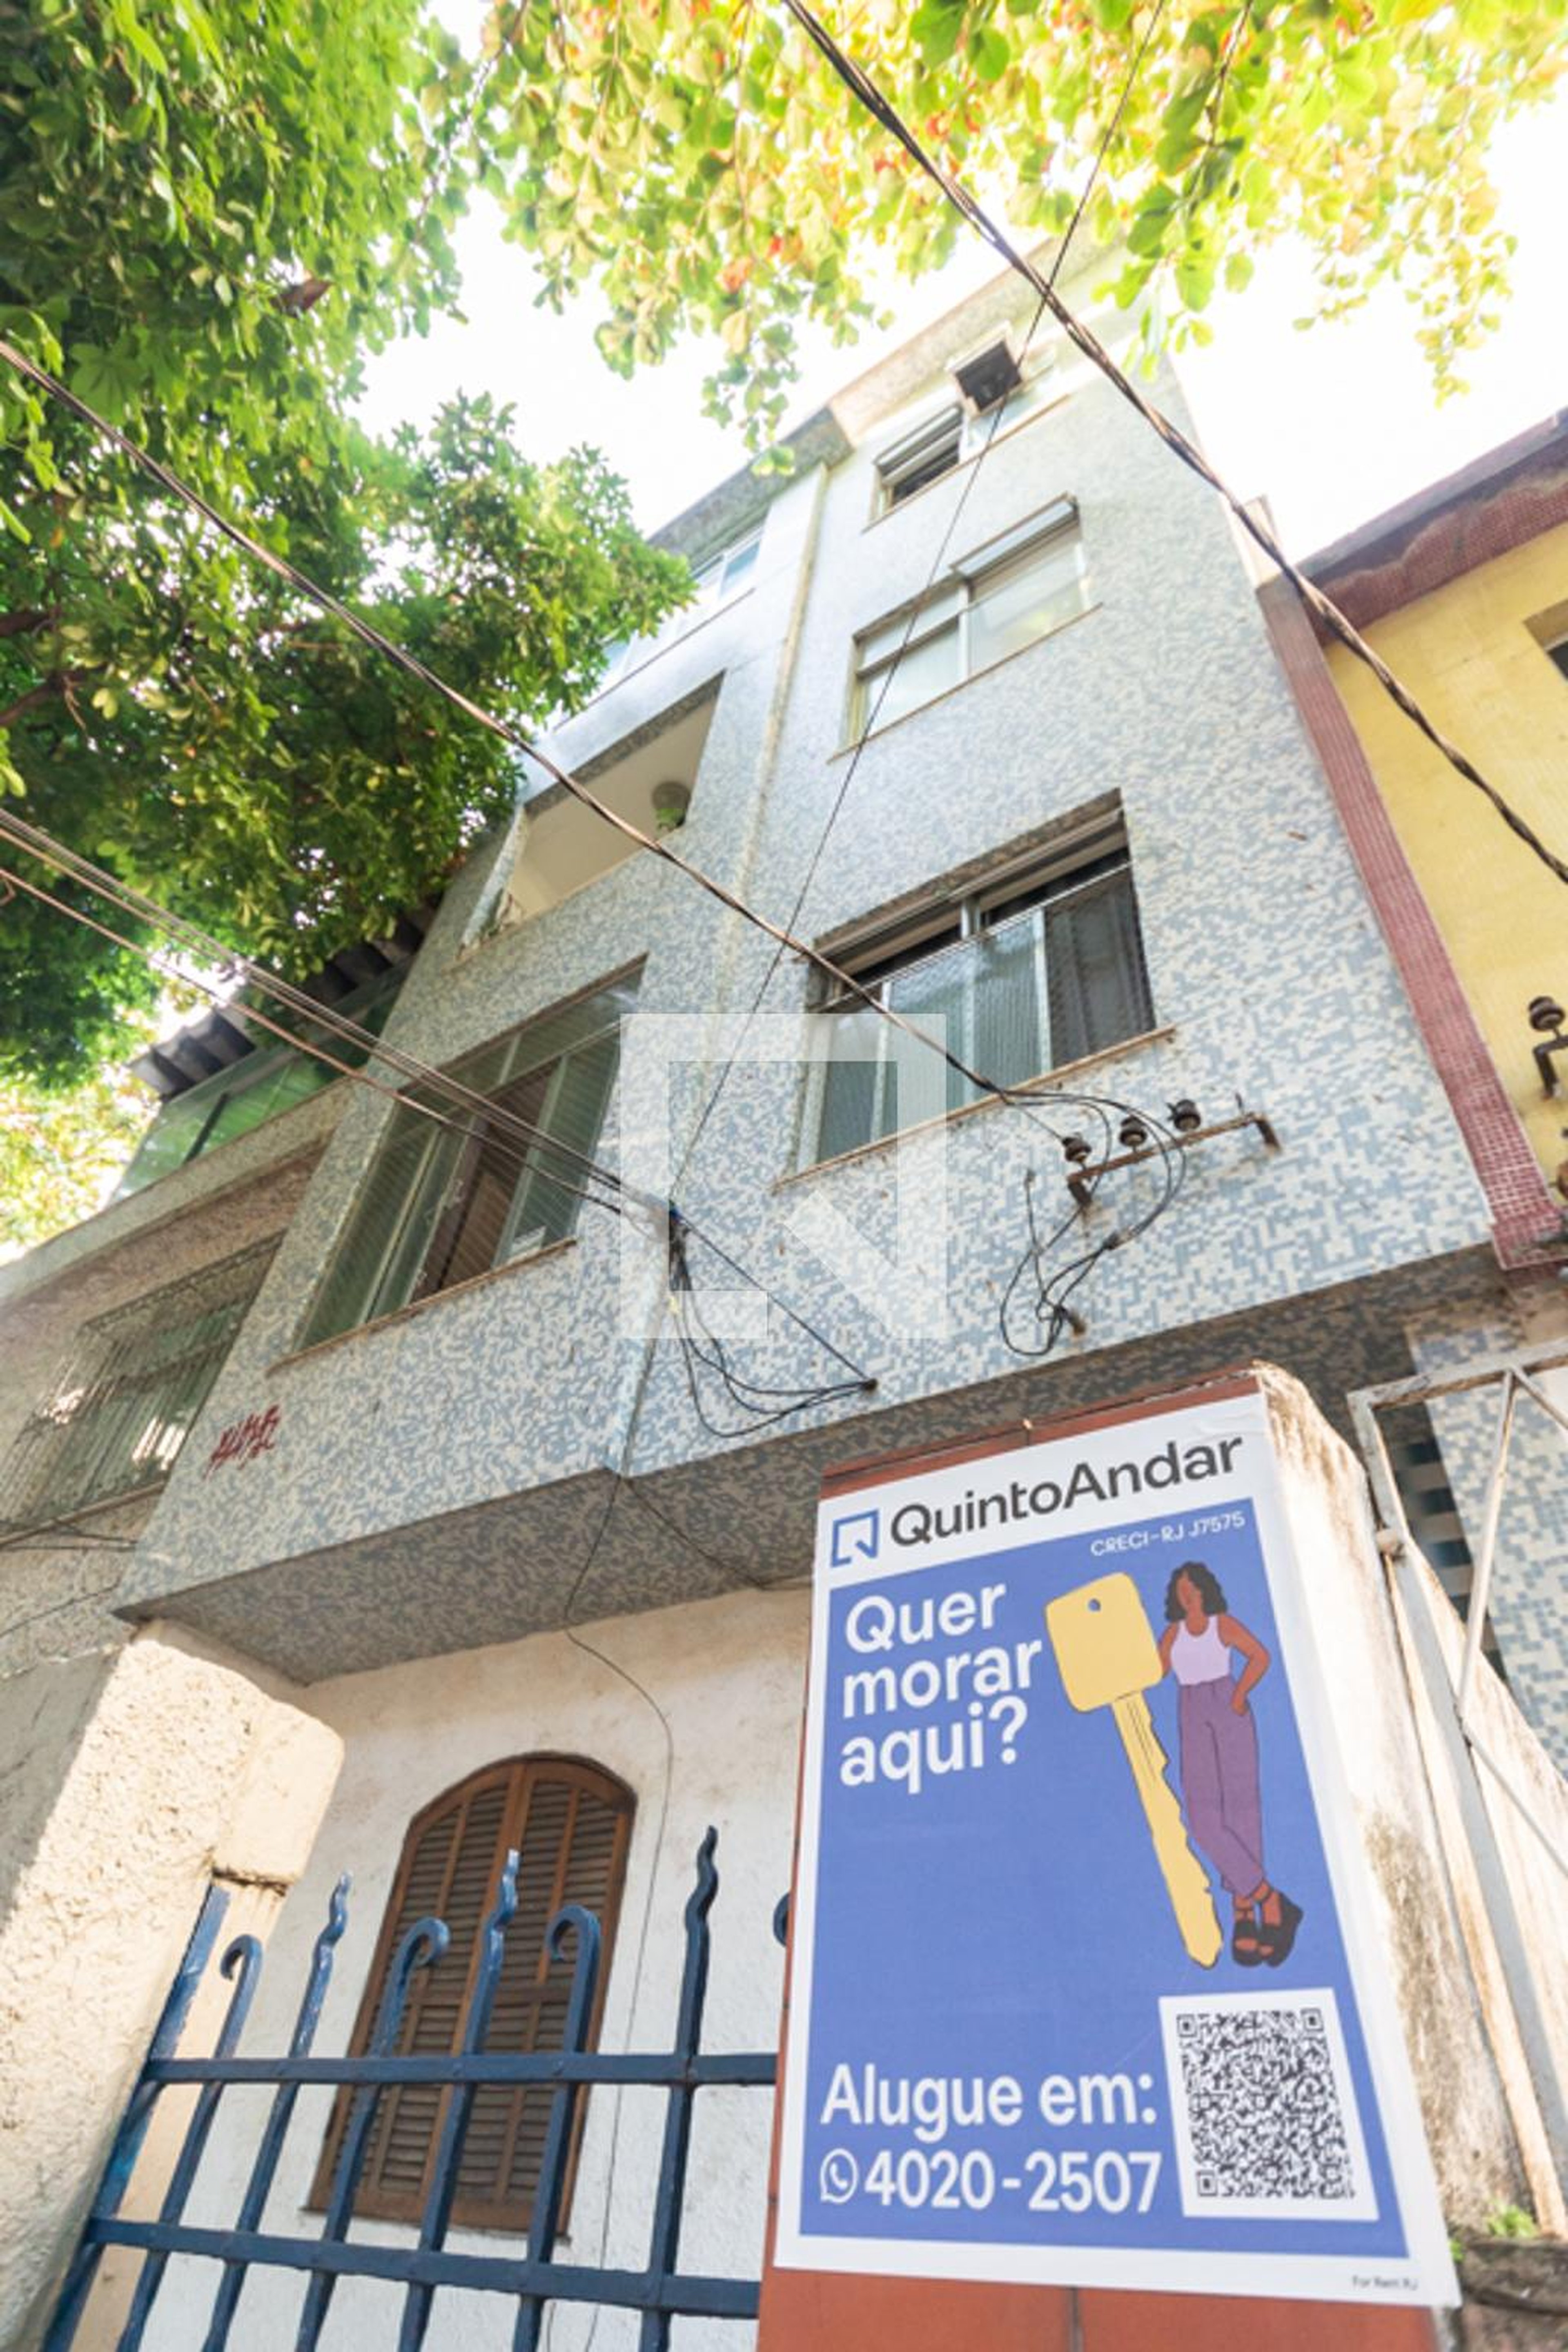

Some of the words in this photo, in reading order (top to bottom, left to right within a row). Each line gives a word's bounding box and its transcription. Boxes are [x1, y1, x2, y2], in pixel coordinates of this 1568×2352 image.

[891, 1437, 1243, 1546] QuintoAndar
[1091, 1524, 1184, 1556] CRECI-RJ
[1187, 1511, 1245, 1537] J7575
[846, 1584, 1006, 1653] Quer
[844, 1640, 1042, 1718] morar
[840, 1696, 1027, 1794] aqui?
[821, 2063, 1022, 2143] Alugue
[1040, 2074, 1156, 2125] em:
[864, 2149, 1161, 2212] 4020-2507
